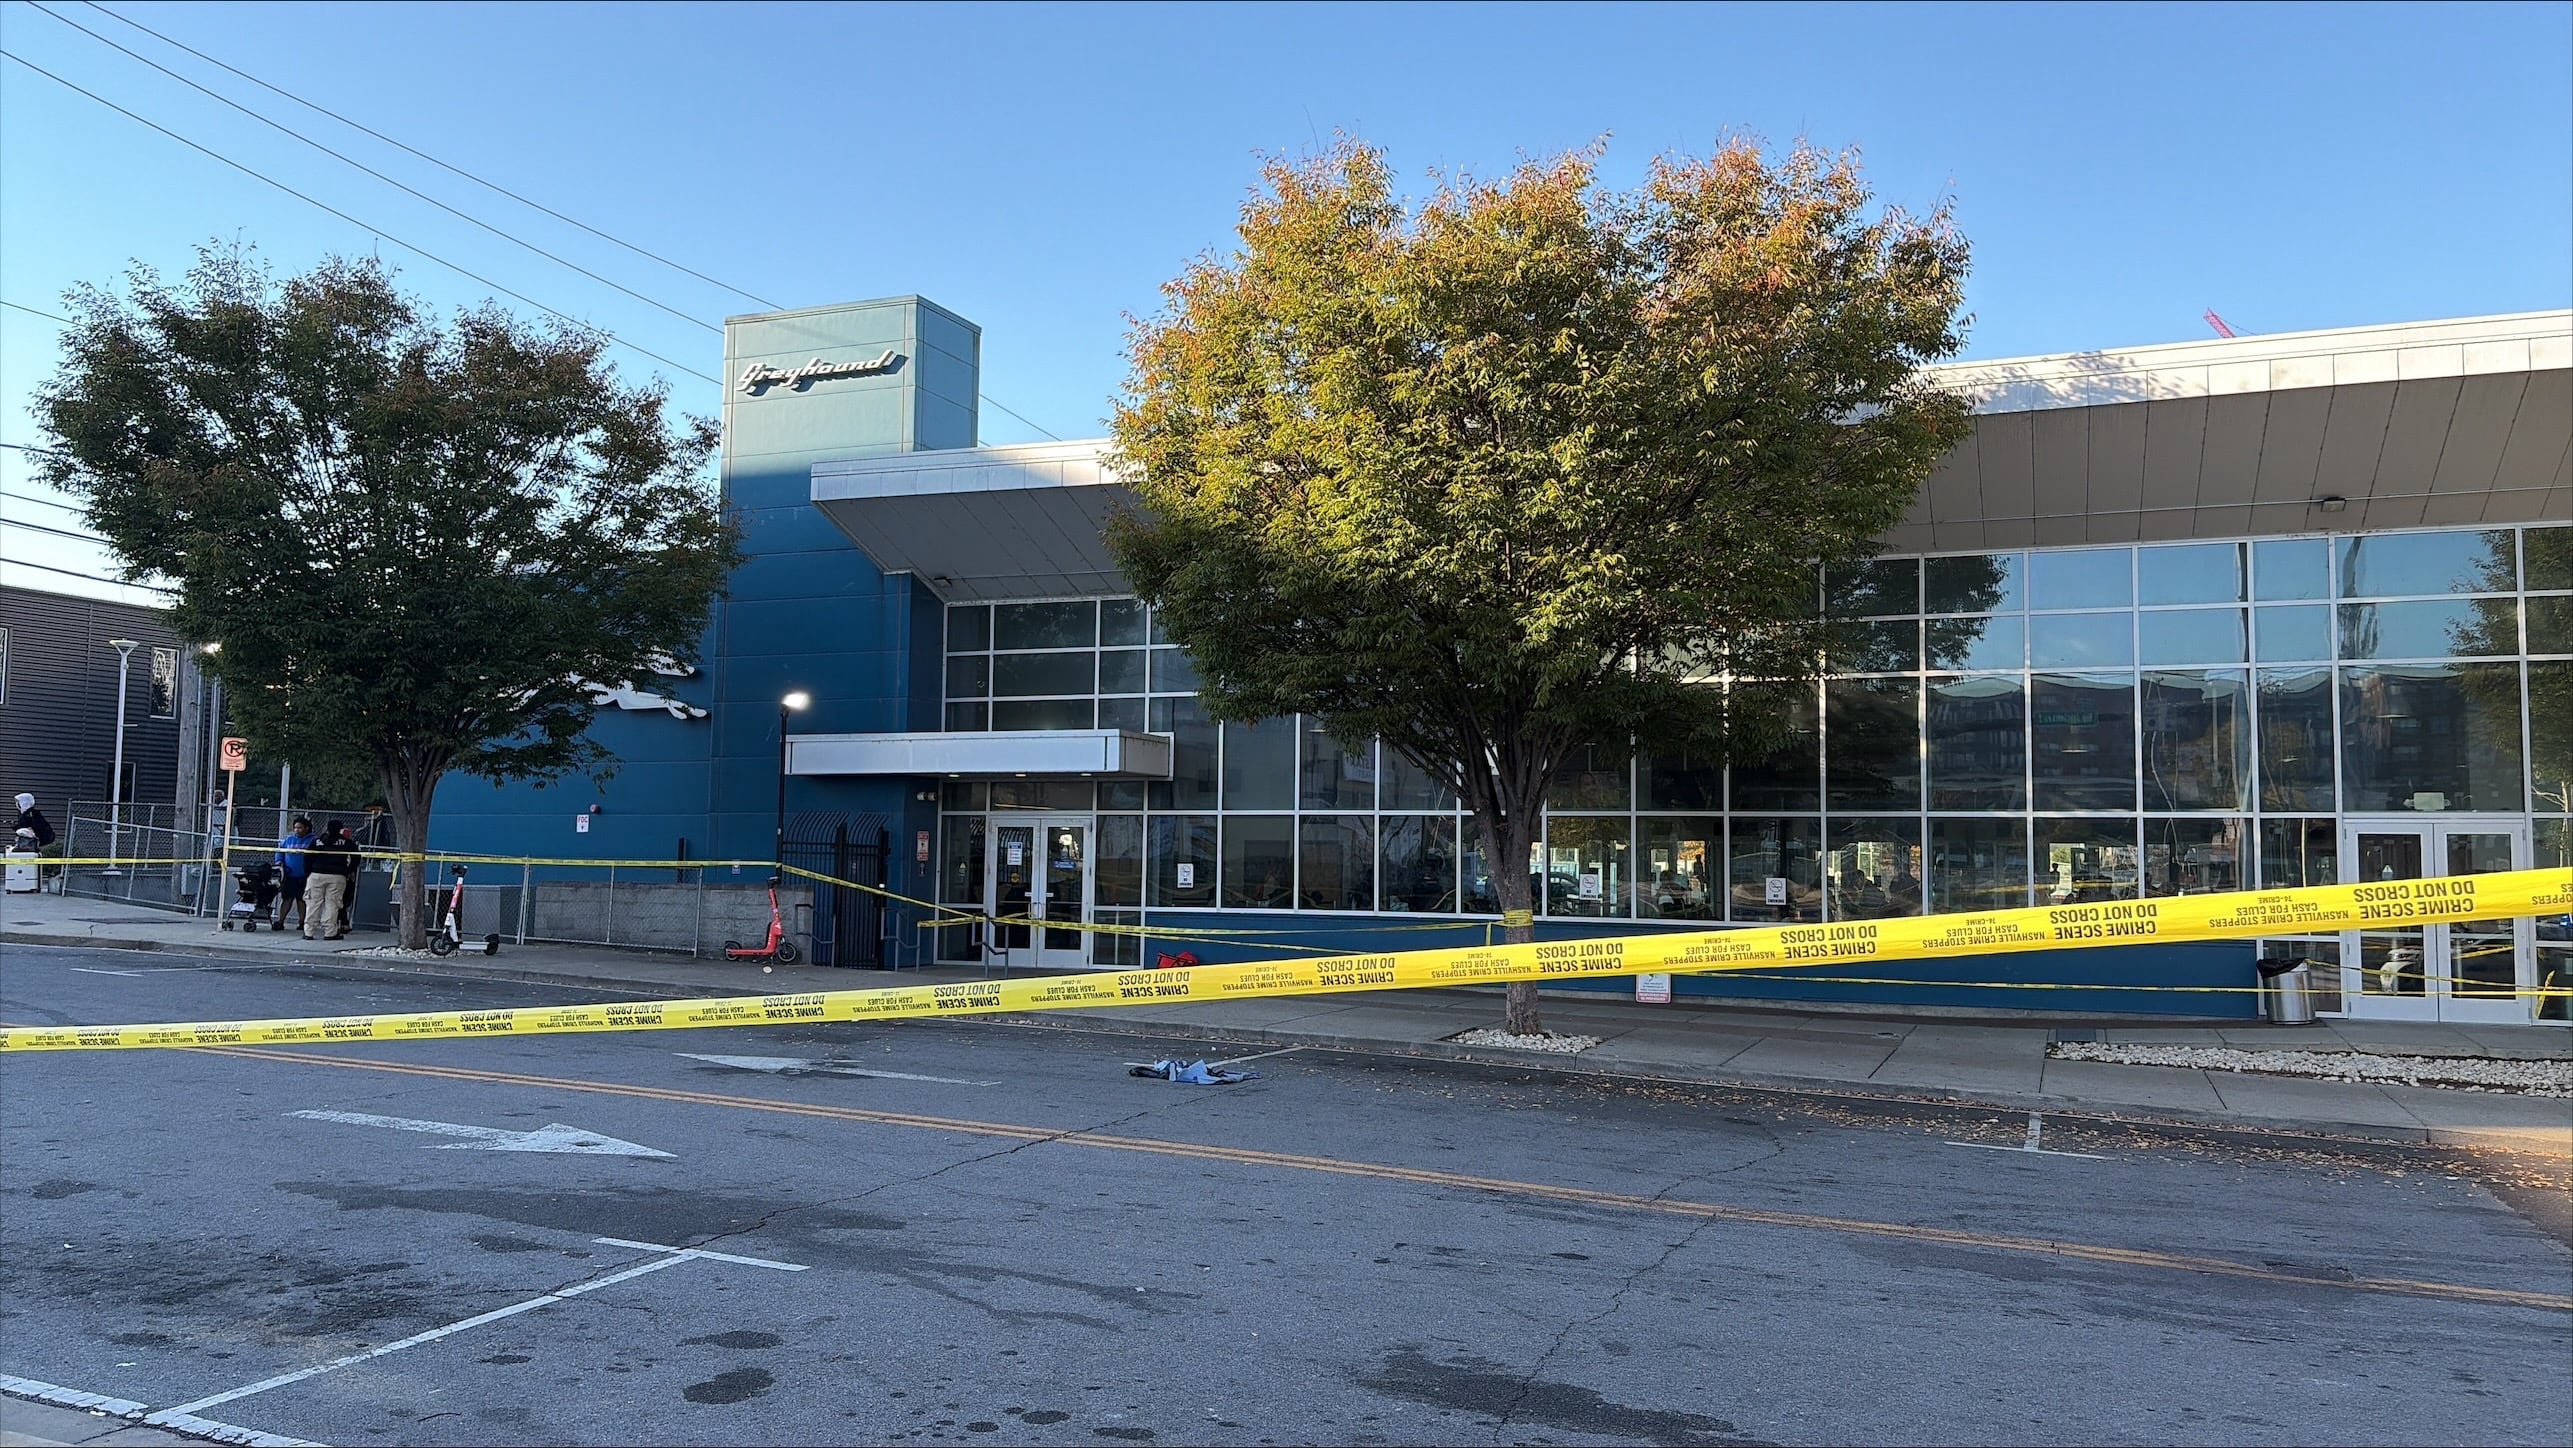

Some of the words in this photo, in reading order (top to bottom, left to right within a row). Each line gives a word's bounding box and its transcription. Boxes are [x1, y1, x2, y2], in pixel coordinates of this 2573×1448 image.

[736, 349, 897, 392] Greyhound
[2353, 885, 2411, 902] CROSS
[2414, 882, 2447, 898] NOT
[2451, 881, 2475, 896] DO
[2258, 895, 2292, 904] 74-CRIME
[2532, 893, 2573, 905] OPPERS
[2135, 904, 2157, 918] DO
[2236, 906, 2266, 916] CLUES
[2268, 904, 2289, 914] FOR
[2292, 902, 2318, 913] CASH
[2360, 902, 2414, 919] SCENE
[2417, 898, 2474, 915] CRIME
[2049, 908, 2100, 924] CROSS
[2102, 905, 2133, 920] NOT
[2296, 910, 2349, 923] NASHVILLE
[1965, 917, 1996, 926] 74-CRIME
[2209, 916, 2258, 928] STOPPERS
[2260, 914, 2293, 925] CRIME
[1828, 927, 1855, 941] NOT
[1858, 925, 1878, 939] DO
[1946, 927, 1973, 937] CLUES
[1974, 926, 1993, 935] FOR
[1995, 924, 2018, 934] CASH
[2054, 924, 2102, 940] SCENE
[2105, 921, 2156, 937] CRIME
[1703, 936, 1731, 944] 74-CRIME
[1779, 929, 1826, 944] CROSS
[1967, 935, 1996, 945] CRIME
[1998, 932, 2045, 943] NASHVILLE
[1730, 943, 1751, 952] CASH
[1922, 937, 1966, 948] STOPPERS
[1535, 945, 1577, 959] CROSS
[1578, 944, 1604, 957] NOT
[1605, 943, 1624, 955] DO
[1685, 946, 1709, 955] CLUES
[1711, 945, 1728, 953] FOR
[1784, 944, 1828, 959] SCENE
[1830, 941, 1876, 956] CRIME
[1663, 955, 1703, 965] STOPPERS
[1704, 953, 1731, 963] CRIME
[1733, 951, 1776, 961] NASHVILLE
[1316, 960, 1354, 973] CROSS
[1355, 958, 1378, 970] NOT
[1379, 957, 1396, 969] DO
[1450, 960, 1472, 969] CLUES
[1474, 959, 1489, 968] FOR
[1490, 958, 1510, 967] CASH
[1538, 960, 1578, 973] SCENE
[1580, 958, 1622, 971] CRIME
[1276, 972, 1293, 980] CASH
[1431, 969, 1467, 978] STOPPERS
[1468, 968, 1491, 976] CRIME
[1493, 966, 1532, 975] NASHVILLE
[1117, 973, 1152, 986] CROSS
[1153, 972, 1174, 984] NOT
[1175, 971, 1190, 982] DO
[1240, 974, 1259, 982] CLUES
[1261, 973, 1274, 981] FOR
[1319, 973, 1355, 986] SCENE
[1356, 971, 1394, 984] CRIME
[933, 986, 965, 997] CROSS
[966, 985, 985, 995] NOT
[987, 984, 1001, 994] DO
[1120, 986, 1153, 998] SCENE
[1154, 984, 1189, 996] CRIME
[762, 997, 792, 1007] CROSS
[792, 996, 810, 1006] NOT
[811, 995, 825, 1005] DO
[936, 998, 966, 1009] SCENE
[968, 996, 999, 1007] CRIME
[604, 1005, 632, 1015] CROSS
[633, 1005, 649, 1014] NOT
[650, 1004, 662, 1013] DO
[765, 1008, 793, 1018] SCENE
[794, 1007, 824, 1017] CRIME
[607, 1016, 633, 1026] SCENE
[635, 1015, 662, 1025] CRIME
